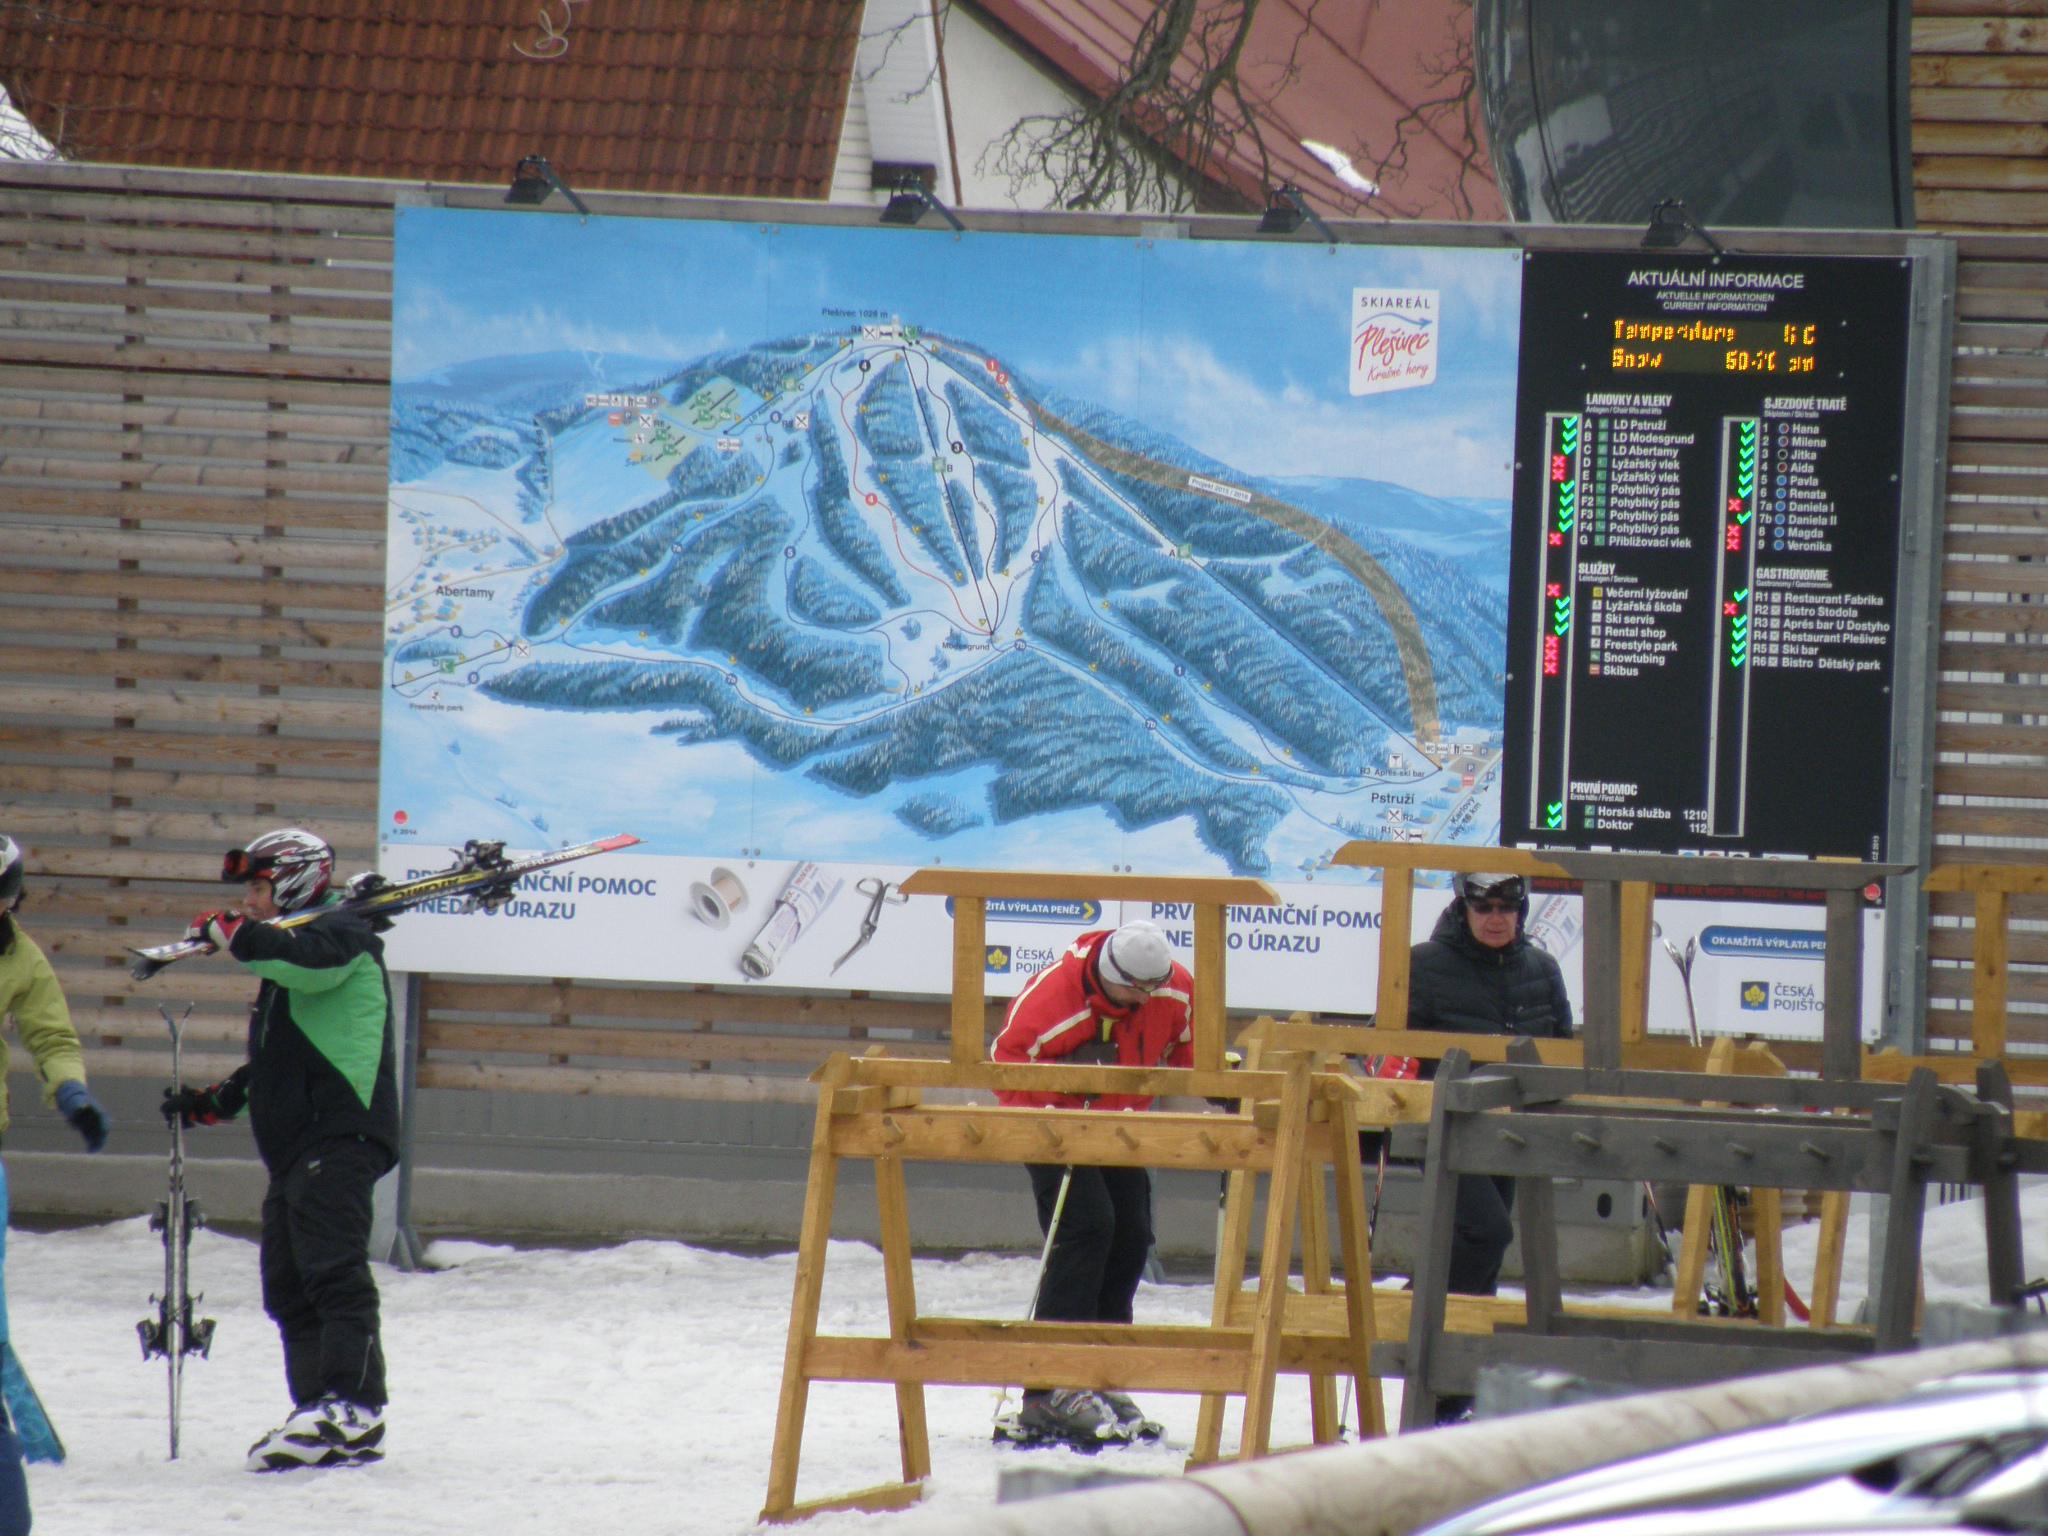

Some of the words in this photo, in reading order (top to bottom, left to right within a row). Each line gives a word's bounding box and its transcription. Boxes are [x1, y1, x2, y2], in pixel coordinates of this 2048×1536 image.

[1627, 269, 1706, 287] AKTUÁLNÍ
[1709, 273, 1804, 288] INFORMACE
[1361, 296, 1431, 309] SKIAREÁL
[1656, 290, 1700, 300] AKTUELLE
[1702, 291, 1775, 302] INFORMATIONEN
[1663, 301, 1706, 311] CURRENT
[1707, 302, 1767, 312] INFORMATION
[1586, 393, 1632, 406] LANOVKY
[1641, 394, 1672, 407] VLEKY
[1764, 396, 1815, 410] SJEZDOVÉ
[1584, 418, 1592, 429] A
[1614, 420, 1628, 430] LD
[1630, 420, 1667, 431] Pstruží
[1762, 423, 1768, 432] 1
[1792, 424, 1820, 435] Hana
[1584, 432, 1592, 442] B
[1613, 433, 1627, 443] LD
[1629, 433, 1695, 446] Modesgrund
[1762, 436, 1769, 446] 2
[1792, 437, 1827, 448] Milena
[1583, 445, 1592, 454] C
[1613, 446, 1627, 455] LD
[1629, 446, 1679, 458] Abertamy
[1762, 449, 1769, 459] 3
[1791, 450, 1817, 460] Jitka
[1583, 458, 1591, 468] D
[1658, 459, 1680, 470] vlek
[1761, 462, 1768, 472] 4
[1790, 463, 1814, 473] Aida
[1582, 471, 1590, 481] E
[1658, 472, 1680, 483] vlek
[1761, 475, 1768, 485] 5
[1790, 475, 1819, 486] Pavla
[1582, 484, 1594, 494] F1
[1611, 484, 1660, 497] Pohyblivý
[1661, 485, 1681, 497] pás
[1760, 488, 1767, 497] 6
[1789, 488, 1827, 499] Renata
[1581, 496, 1594, 506] F2
[1610, 497, 1659, 510] Pohyblivý
[1661, 498, 1680, 510] pás
[1760, 501, 1773, 511] 7a
[1789, 502, 1829, 513] Daniela
[1581, 509, 1594, 519] F3
[1610, 510, 1659, 523] Pohyblivý
[1660, 511, 1680, 523] pás
[1759, 514, 1772, 524] 7b
[1788, 515, 1829, 525] Daniela
[1580, 522, 1593, 532] F4
[1609, 523, 1659, 536] Pohyblivý
[1660, 524, 1680, 535] pás
[1758, 527, 1766, 536] 8
[1788, 527, 1824, 539] Magda
[1579, 535, 1588, 545] G
[1670, 537, 1692, 548] vlek
[1758, 540, 1765, 550] 9
[1787, 541, 1832, 551] Veronika
[1578, 561, 1616, 575] SLUŽBY
[1756, 568, 1829, 581] GASTRONOMIE
[435, 585, 495, 600] Abertamy
[1606, 588, 1644, 598] Večerní
[1646, 588, 1688, 600] lyžování
[1755, 592, 1768, 602] R1
[1784, 593, 1842, 604] Restaurant
[1844, 594, 1884, 606] Fabrika
[1606, 601, 1652, 613] Lyžařská
[1654, 602, 1682, 612] škola
[1754, 605, 1769, 615] R2
[1784, 606, 1816, 616] Bistro
[1817, 606, 1858, 617] Stodola
[1605, 614, 1622, 623] Ski
[1624, 615, 1655, 624] servis
[1754, 618, 1768, 628] R3
[1816, 620, 1833, 630] bar
[1836, 620, 1844, 630] U
[1847, 620, 1890, 633] Dostyho
[1605, 626, 1639, 637] Rental
[1640, 627, 1667, 640] shop
[1753, 631, 1768, 641] R4
[1783, 632, 1840, 643] Restaurant
[1843, 633, 1887, 644] Plešivec
[1604, 639, 1653, 652] Freestyle
[1654, 641, 1678, 652] park
[1753, 643, 1767, 653] R5
[1782, 644, 1799, 655] Ski
[1801, 645, 1819, 655] bar
[1604, 651, 1665, 666] Snowtubing
[1752, 656, 1766, 666] R6
[1781, 657, 1814, 668] Bistro
[1856, 659, 1881, 672] park
[1603, 665, 1639, 676] Skibus
[1570, 780, 1601, 794] PRVNÍ
[1602, 782, 1637, 796] POMOC
[1371, 792, 1415, 805] Pstruží
[1597, 806, 1635, 817] Horská
[1636, 807, 1671, 819] služba
[1683, 810, 1707, 820] 1210
[1597, 819, 1634, 830] Doktor
[1689, 823, 1707, 833] 112
[578, 876, 657, 896] POMOC
[1007, 901, 1049, 914] VÝPLATA
[1050, 903, 1080, 915] PENĚZ
[1151, 903, 1195, 920] PRV
[1225, 904, 1317, 926] INANČNÍ
[1323, 910, 1382, 929] POMO
[1248, 928, 1321, 953] ÚRAZU
[1711, 935, 1763, 948] OKAMŽITÁ
[1765, 936, 1809, 950] VÝPLATA
[1015, 946, 1055, 961] ČESKÁ
[1774, 982, 1815, 998] ČESKÁ
[1773, 998, 1825, 1012] POJIŠŤO
